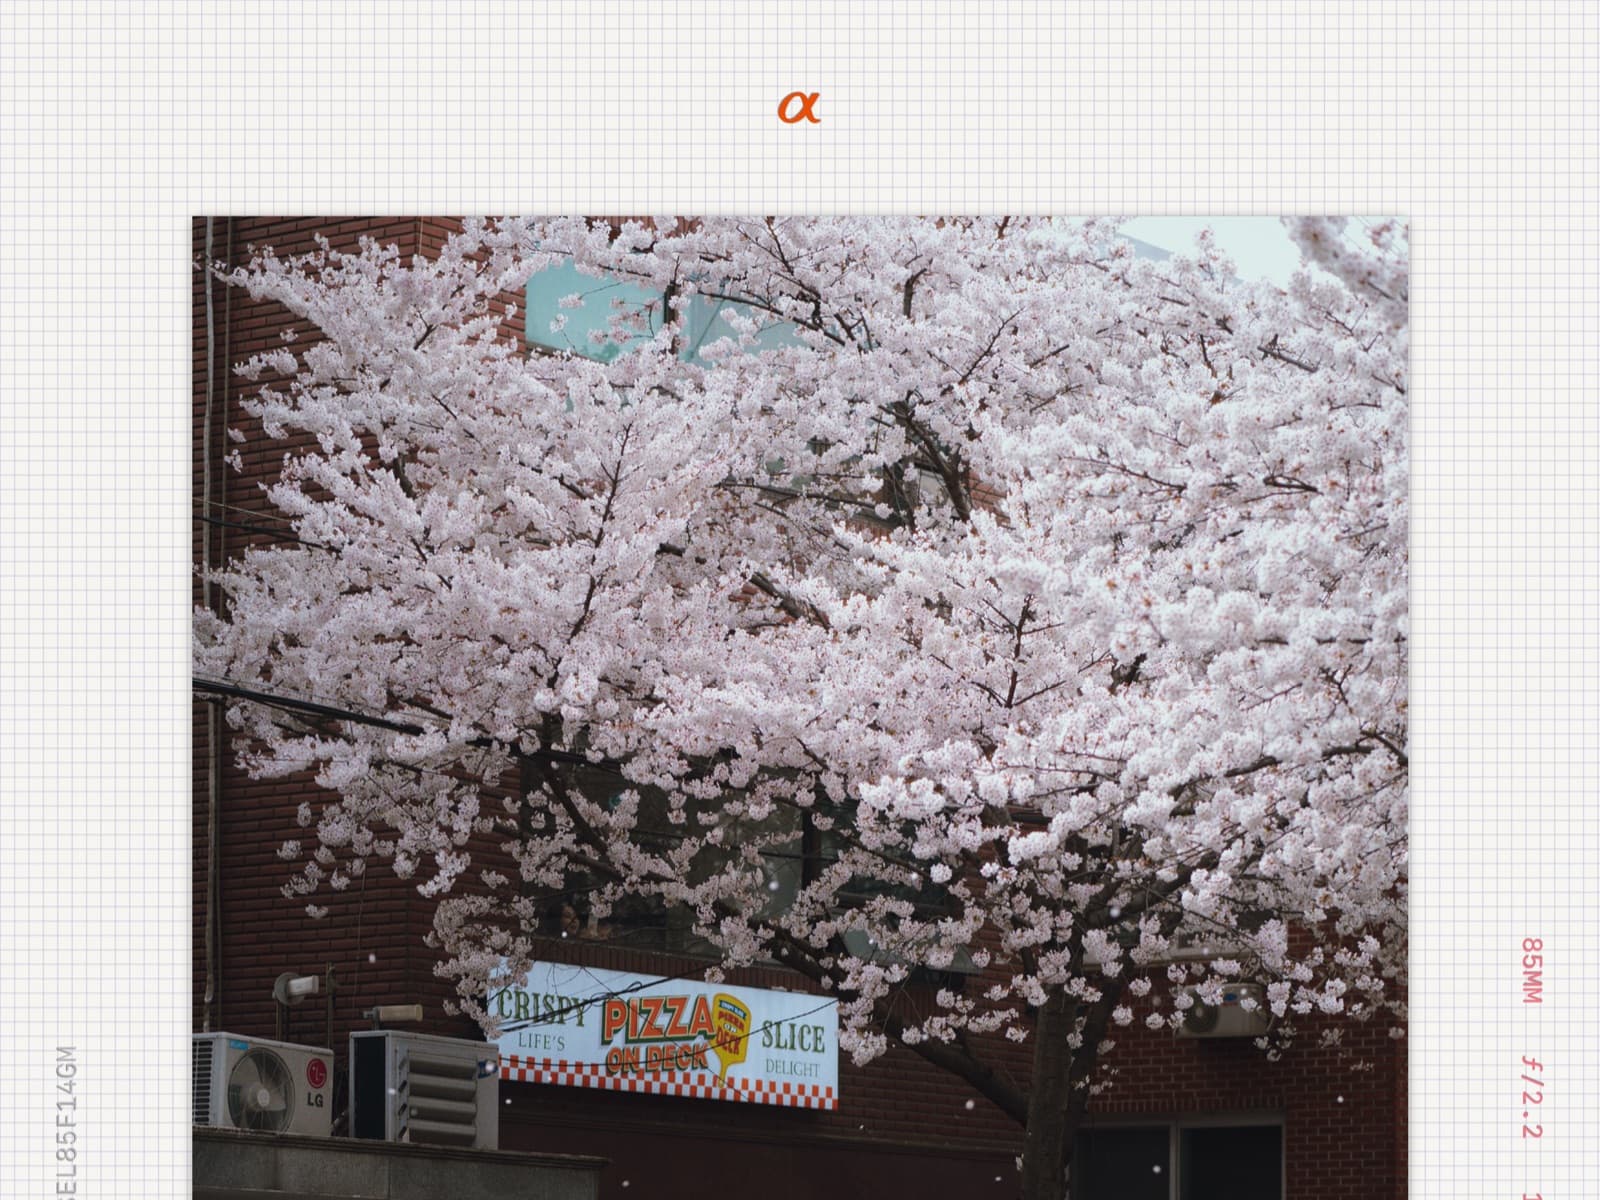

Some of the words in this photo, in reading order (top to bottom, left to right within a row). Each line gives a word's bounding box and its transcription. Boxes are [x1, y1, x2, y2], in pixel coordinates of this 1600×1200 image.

[497, 988, 588, 1027] CRISPY
[601, 993, 717, 1045] PIZZA
[518, 1031, 566, 1052] LIFE'S
[761, 1019, 826, 1054] SLICE
[605, 1046, 644, 1076] ON
[645, 1047, 710, 1074] DECK
[765, 1058, 821, 1078] DELIGHT
[307, 1092, 324, 1108] LG
